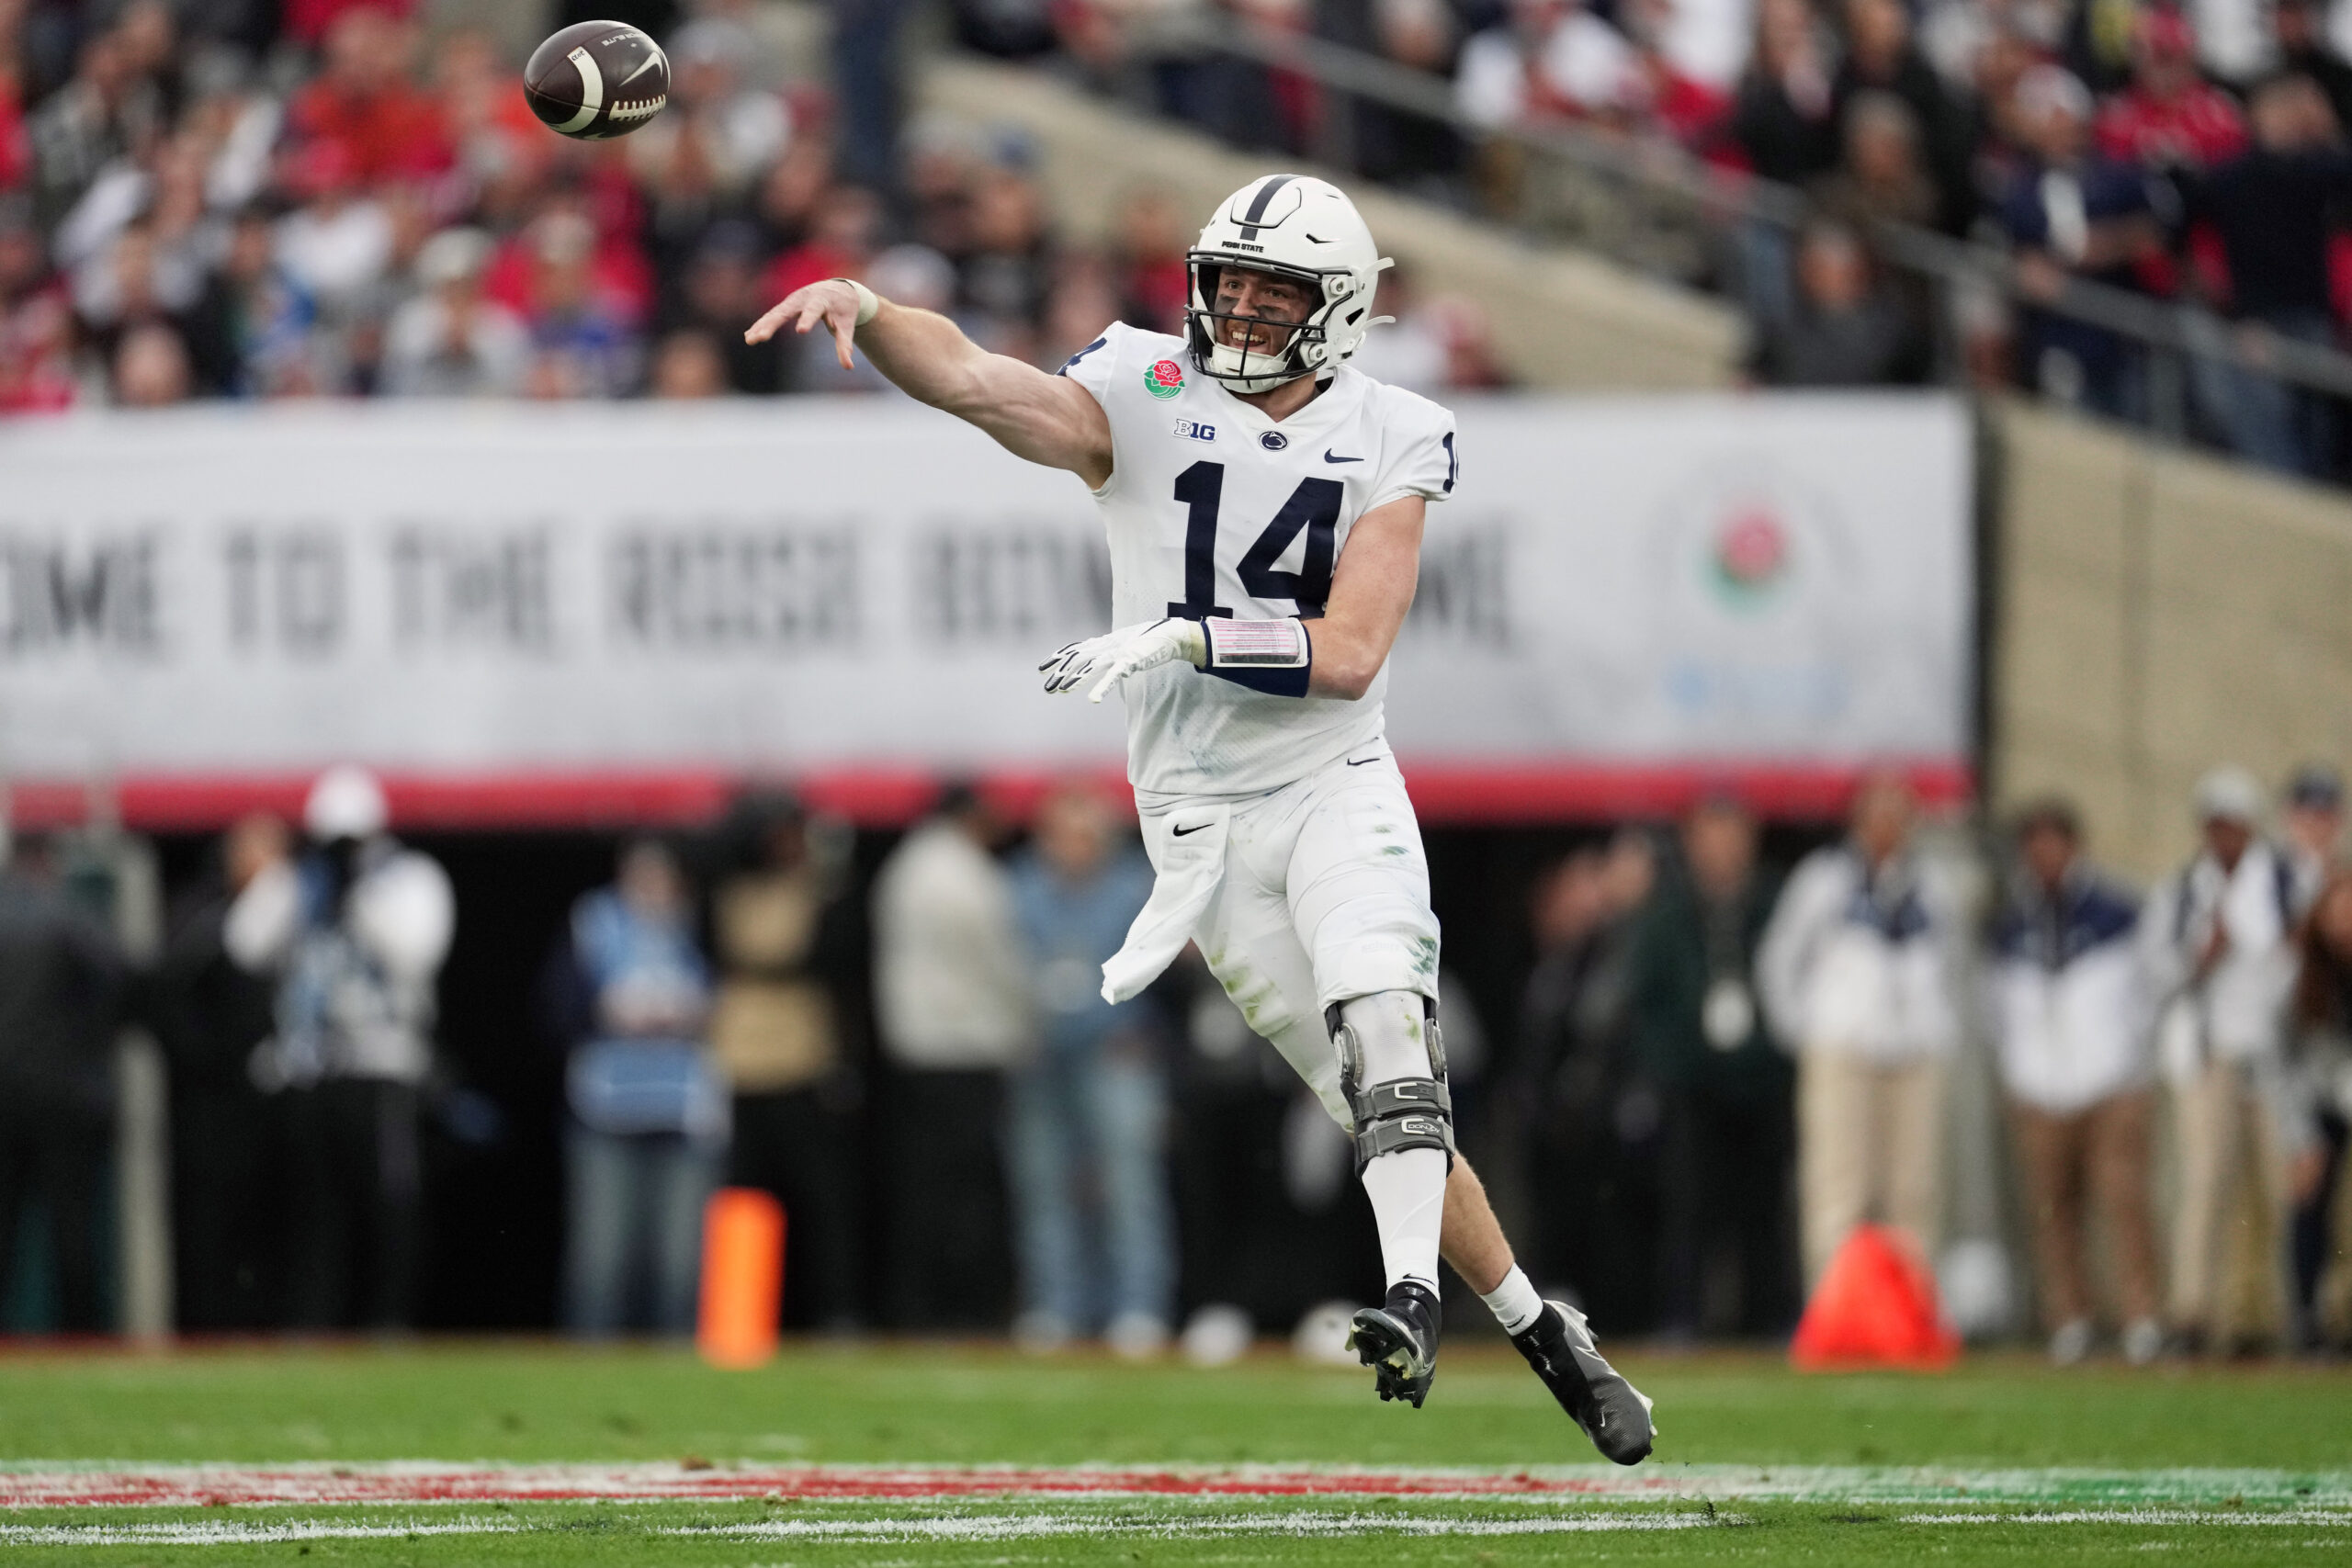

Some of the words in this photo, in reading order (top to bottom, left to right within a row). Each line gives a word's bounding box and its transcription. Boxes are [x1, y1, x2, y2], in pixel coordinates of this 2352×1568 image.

[1221, 241, 1240, 250] PENN
[1241, 243, 1264, 253] STATE
[220, 522, 351, 654] TO
[919, 520, 1113, 647] BOW
[1167, 459, 1344, 620] 14
